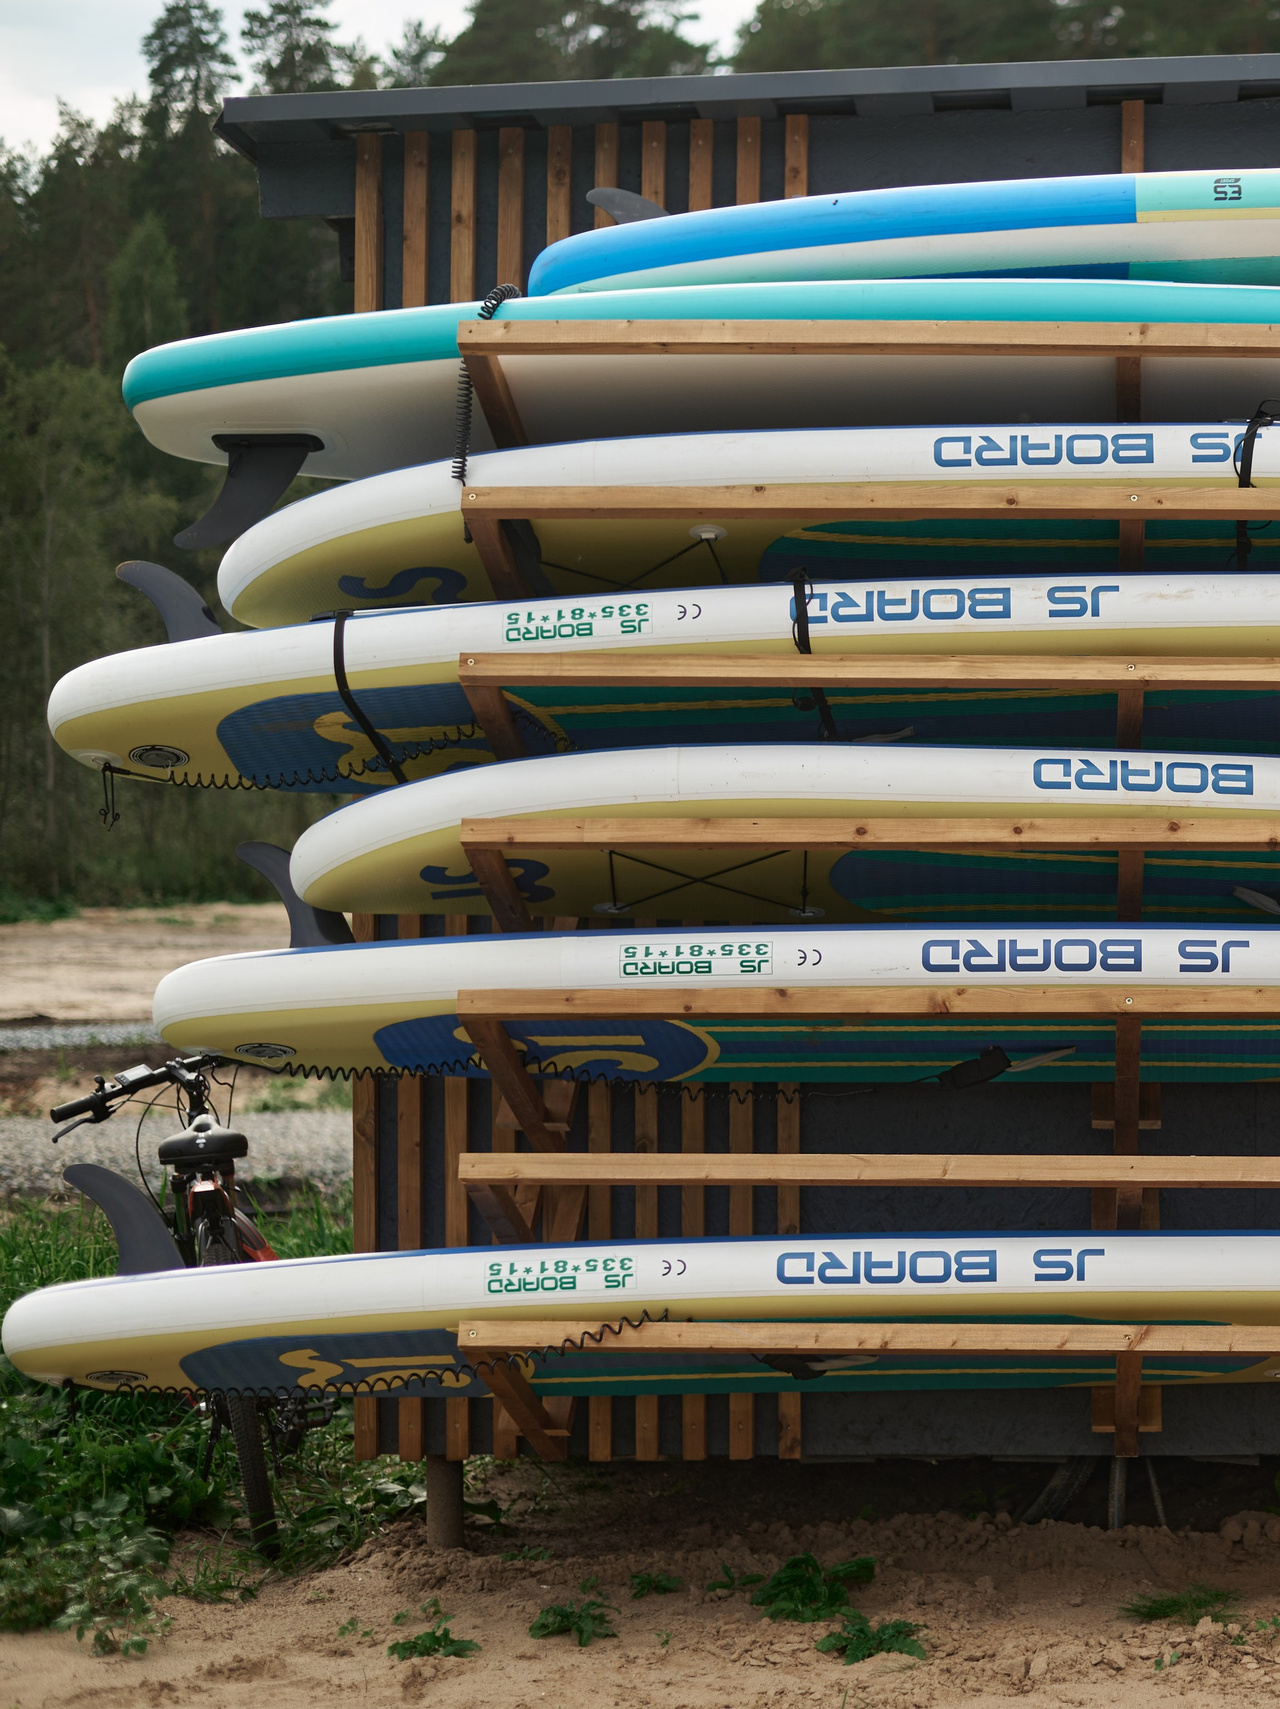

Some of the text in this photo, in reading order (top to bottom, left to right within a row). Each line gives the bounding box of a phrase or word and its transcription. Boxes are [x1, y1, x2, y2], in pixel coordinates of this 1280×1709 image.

[933, 434, 1154, 468] BOARD
[1047, 585, 1120, 618] JS
[505, 618, 650, 643] JS BOARD
[1033, 758, 1254, 795] BOARD
[623, 959, 768, 976] JS BOARD
[922, 939, 1250, 972] JS BOARD
[776, 1248, 1105, 1285] JS BOARD
[487, 1273, 633, 1294] JS BOARD
